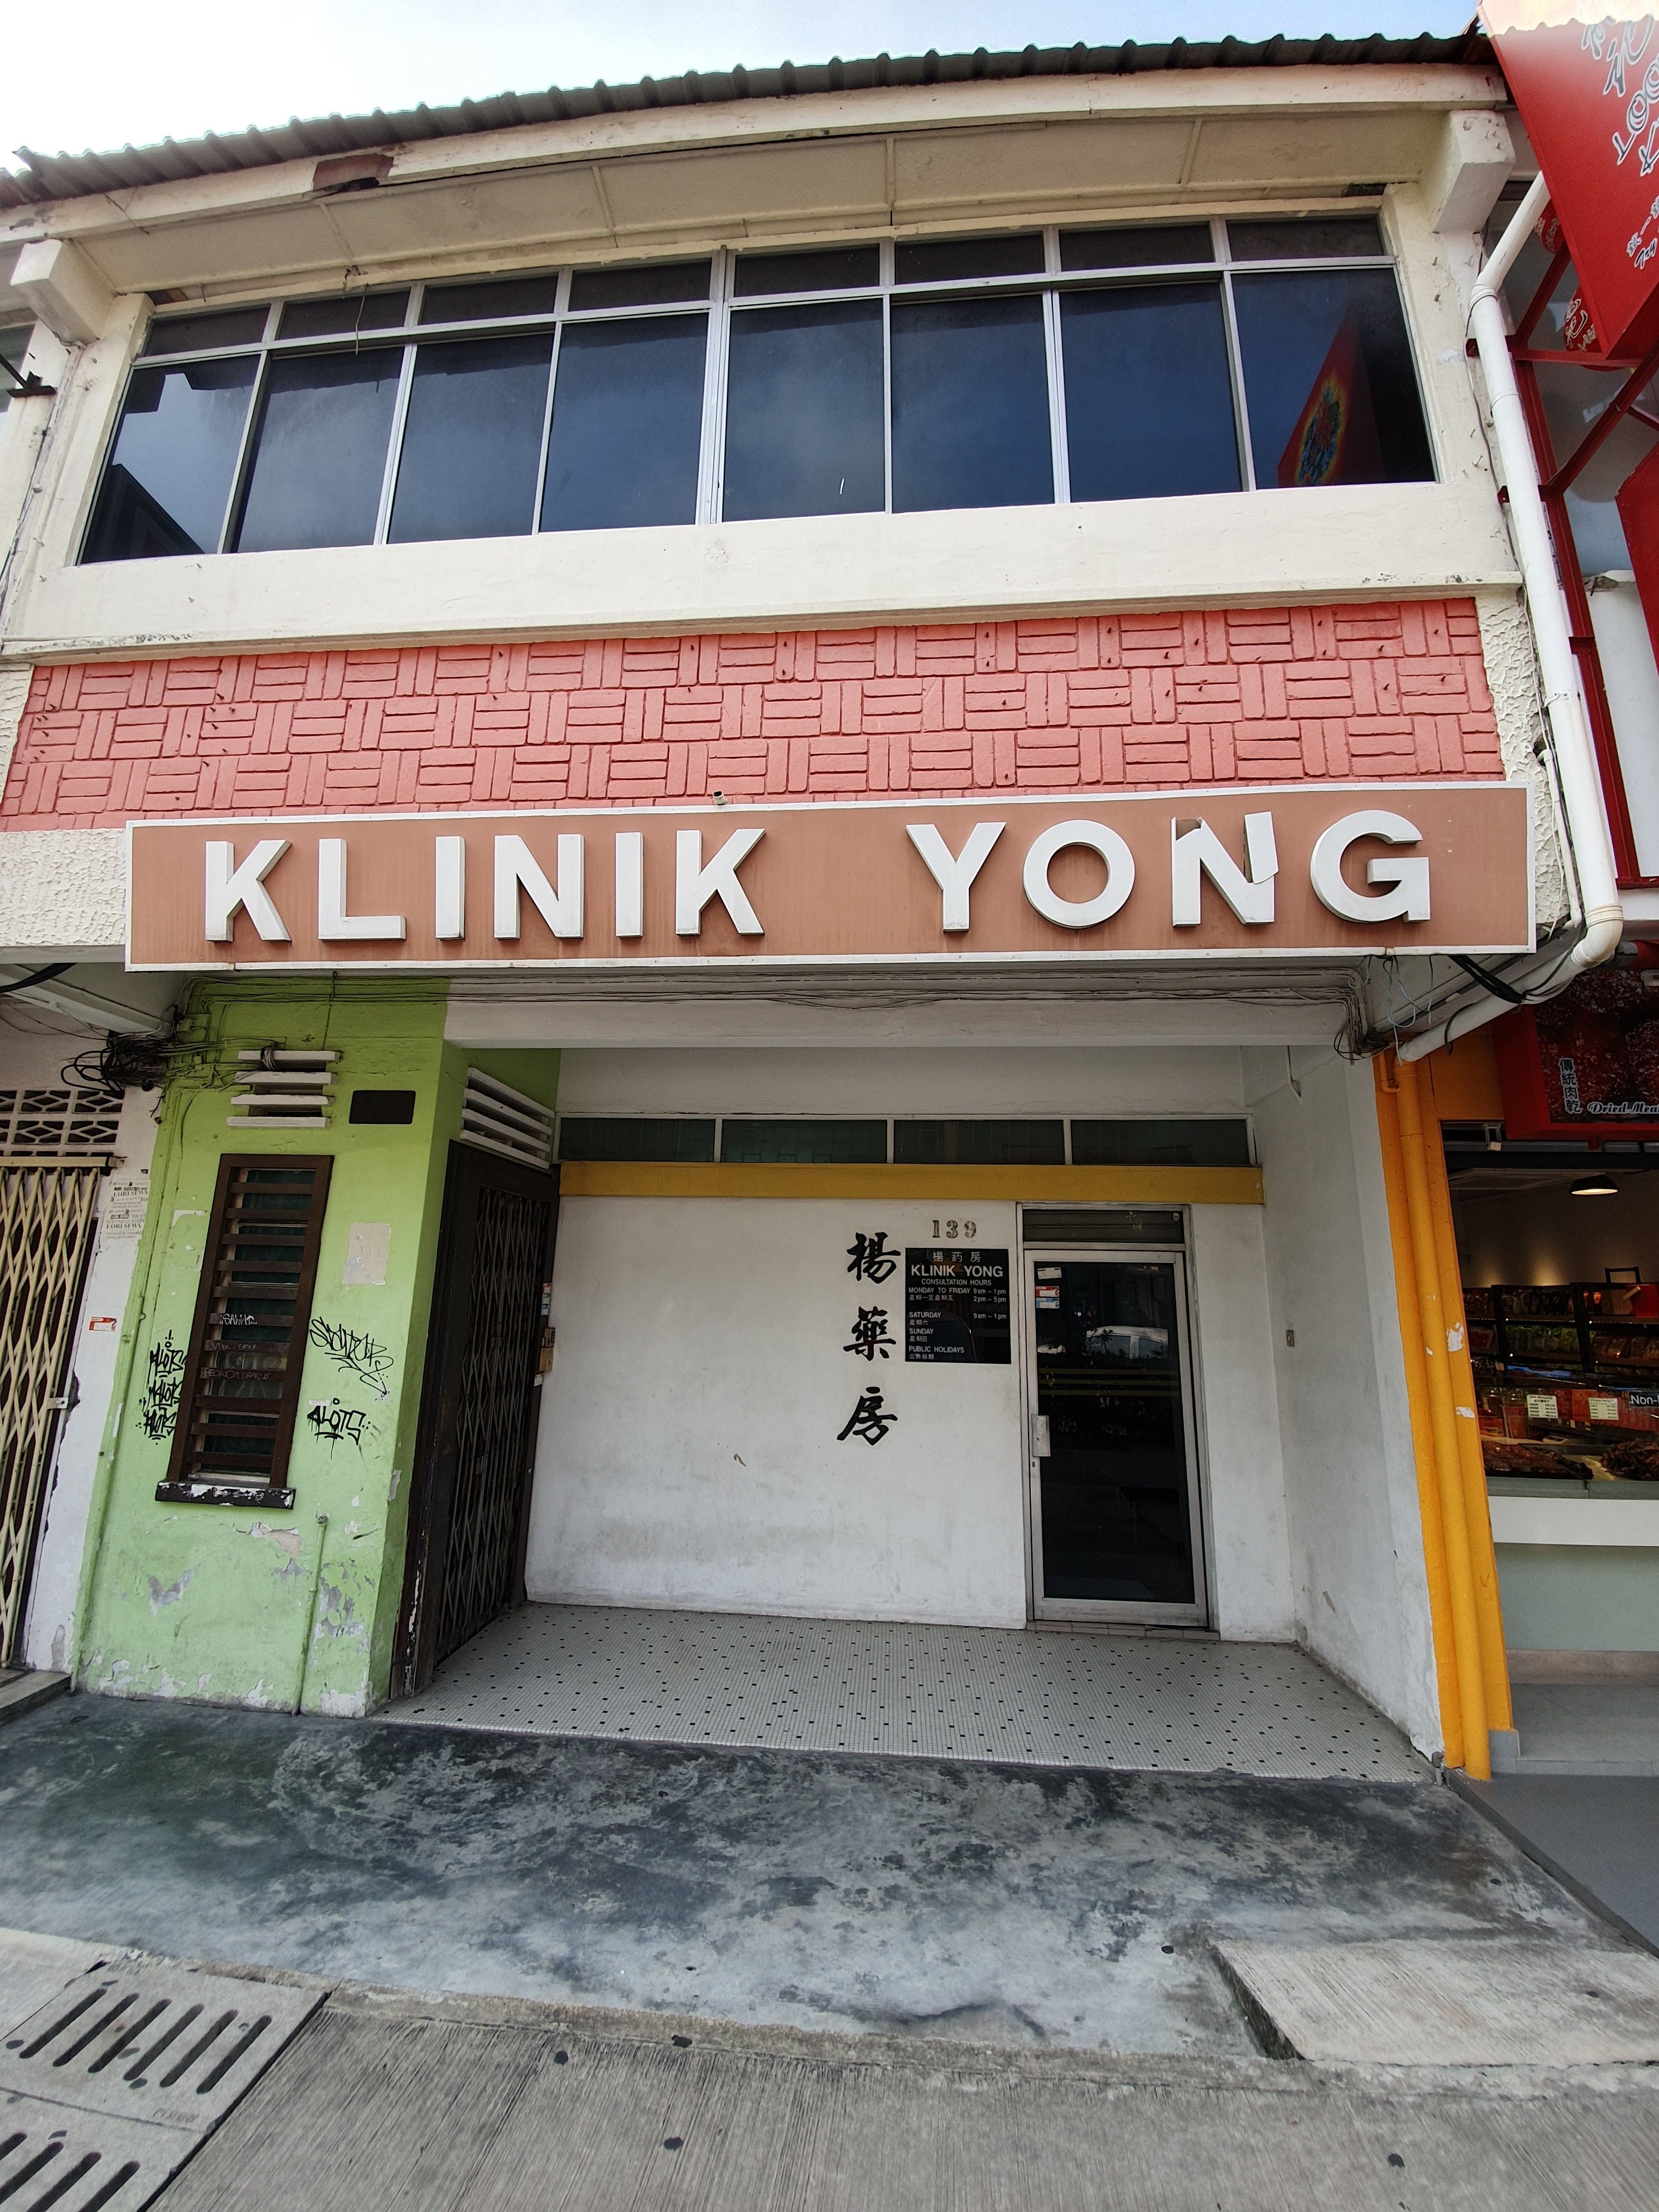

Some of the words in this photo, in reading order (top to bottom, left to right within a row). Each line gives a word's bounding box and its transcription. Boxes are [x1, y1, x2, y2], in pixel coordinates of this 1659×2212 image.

[205, 829, 766, 942] KLINIK
[905, 809, 1431, 933] YONG
[1587, 1102, 1628, 1114] Dried
[1630, 1102, 1659, 1114] Mea
[932, 1220, 977, 1238] 139
[911, 1264, 956, 1276] KLINIK
[963, 1265, 1003, 1277] YONG
